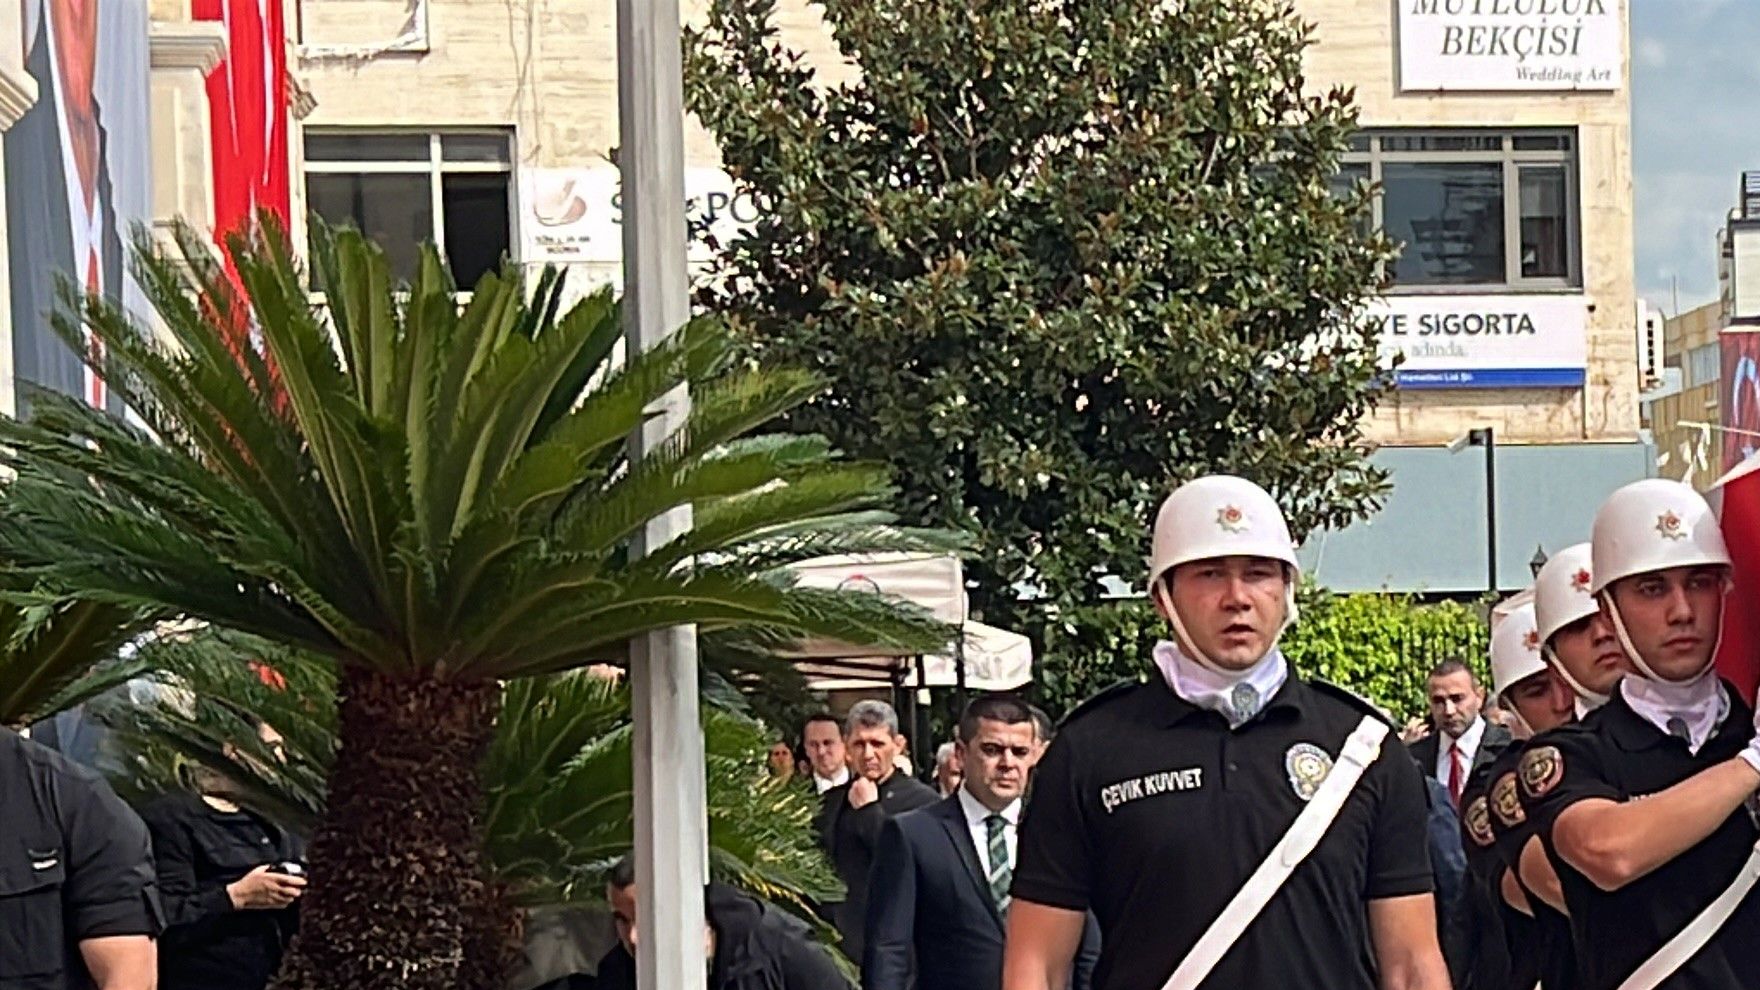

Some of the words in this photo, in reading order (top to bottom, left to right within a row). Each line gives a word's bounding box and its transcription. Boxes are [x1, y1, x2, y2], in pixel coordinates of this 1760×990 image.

[1440, 18, 1584, 62] BEKÇİSİ
[1516, 66, 1583, 83] Wedding
[1586, 67, 1612, 81] Art
[1144, 768, 1202, 796] KUVVET
